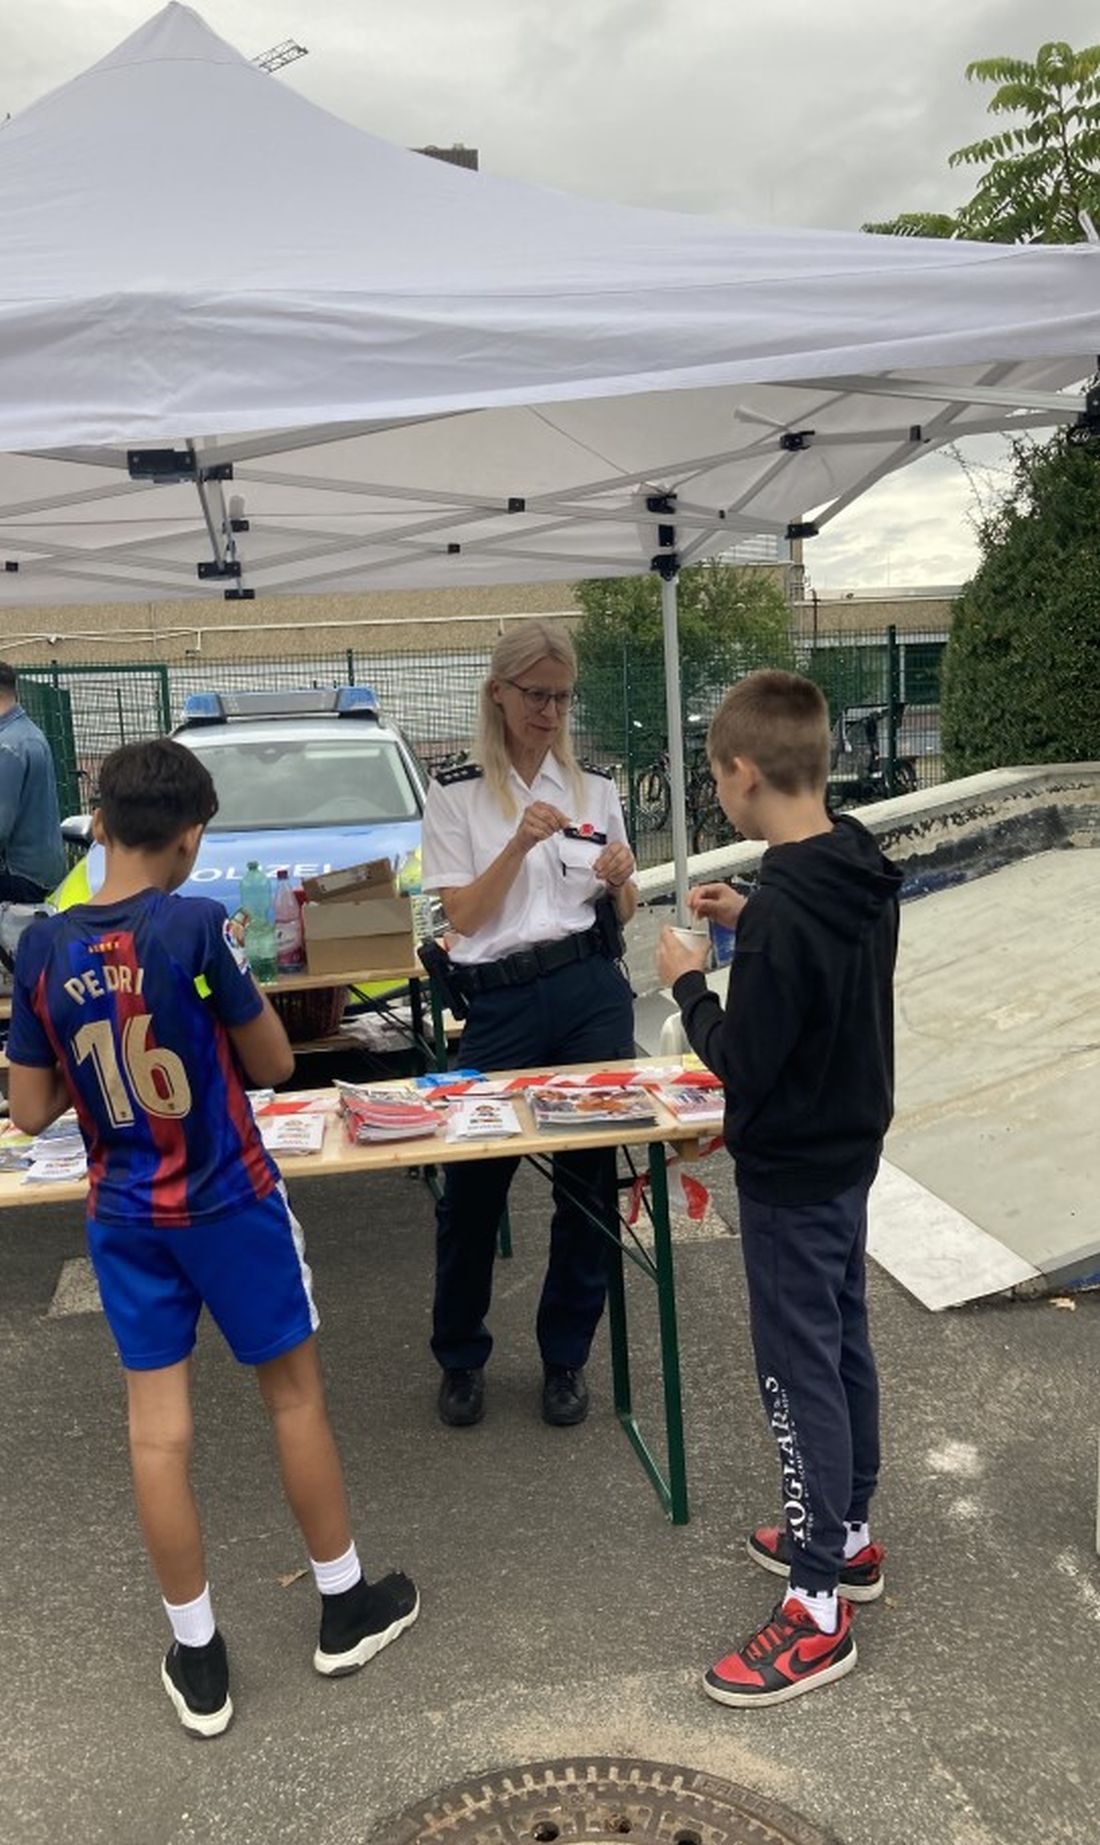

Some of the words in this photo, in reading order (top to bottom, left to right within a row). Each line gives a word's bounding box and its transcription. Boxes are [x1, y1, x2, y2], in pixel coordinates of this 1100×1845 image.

[189, 863, 332, 883] OLZEI
[64, 964, 144, 1005] PEDRI
[71, 1014, 192, 1129] 16
